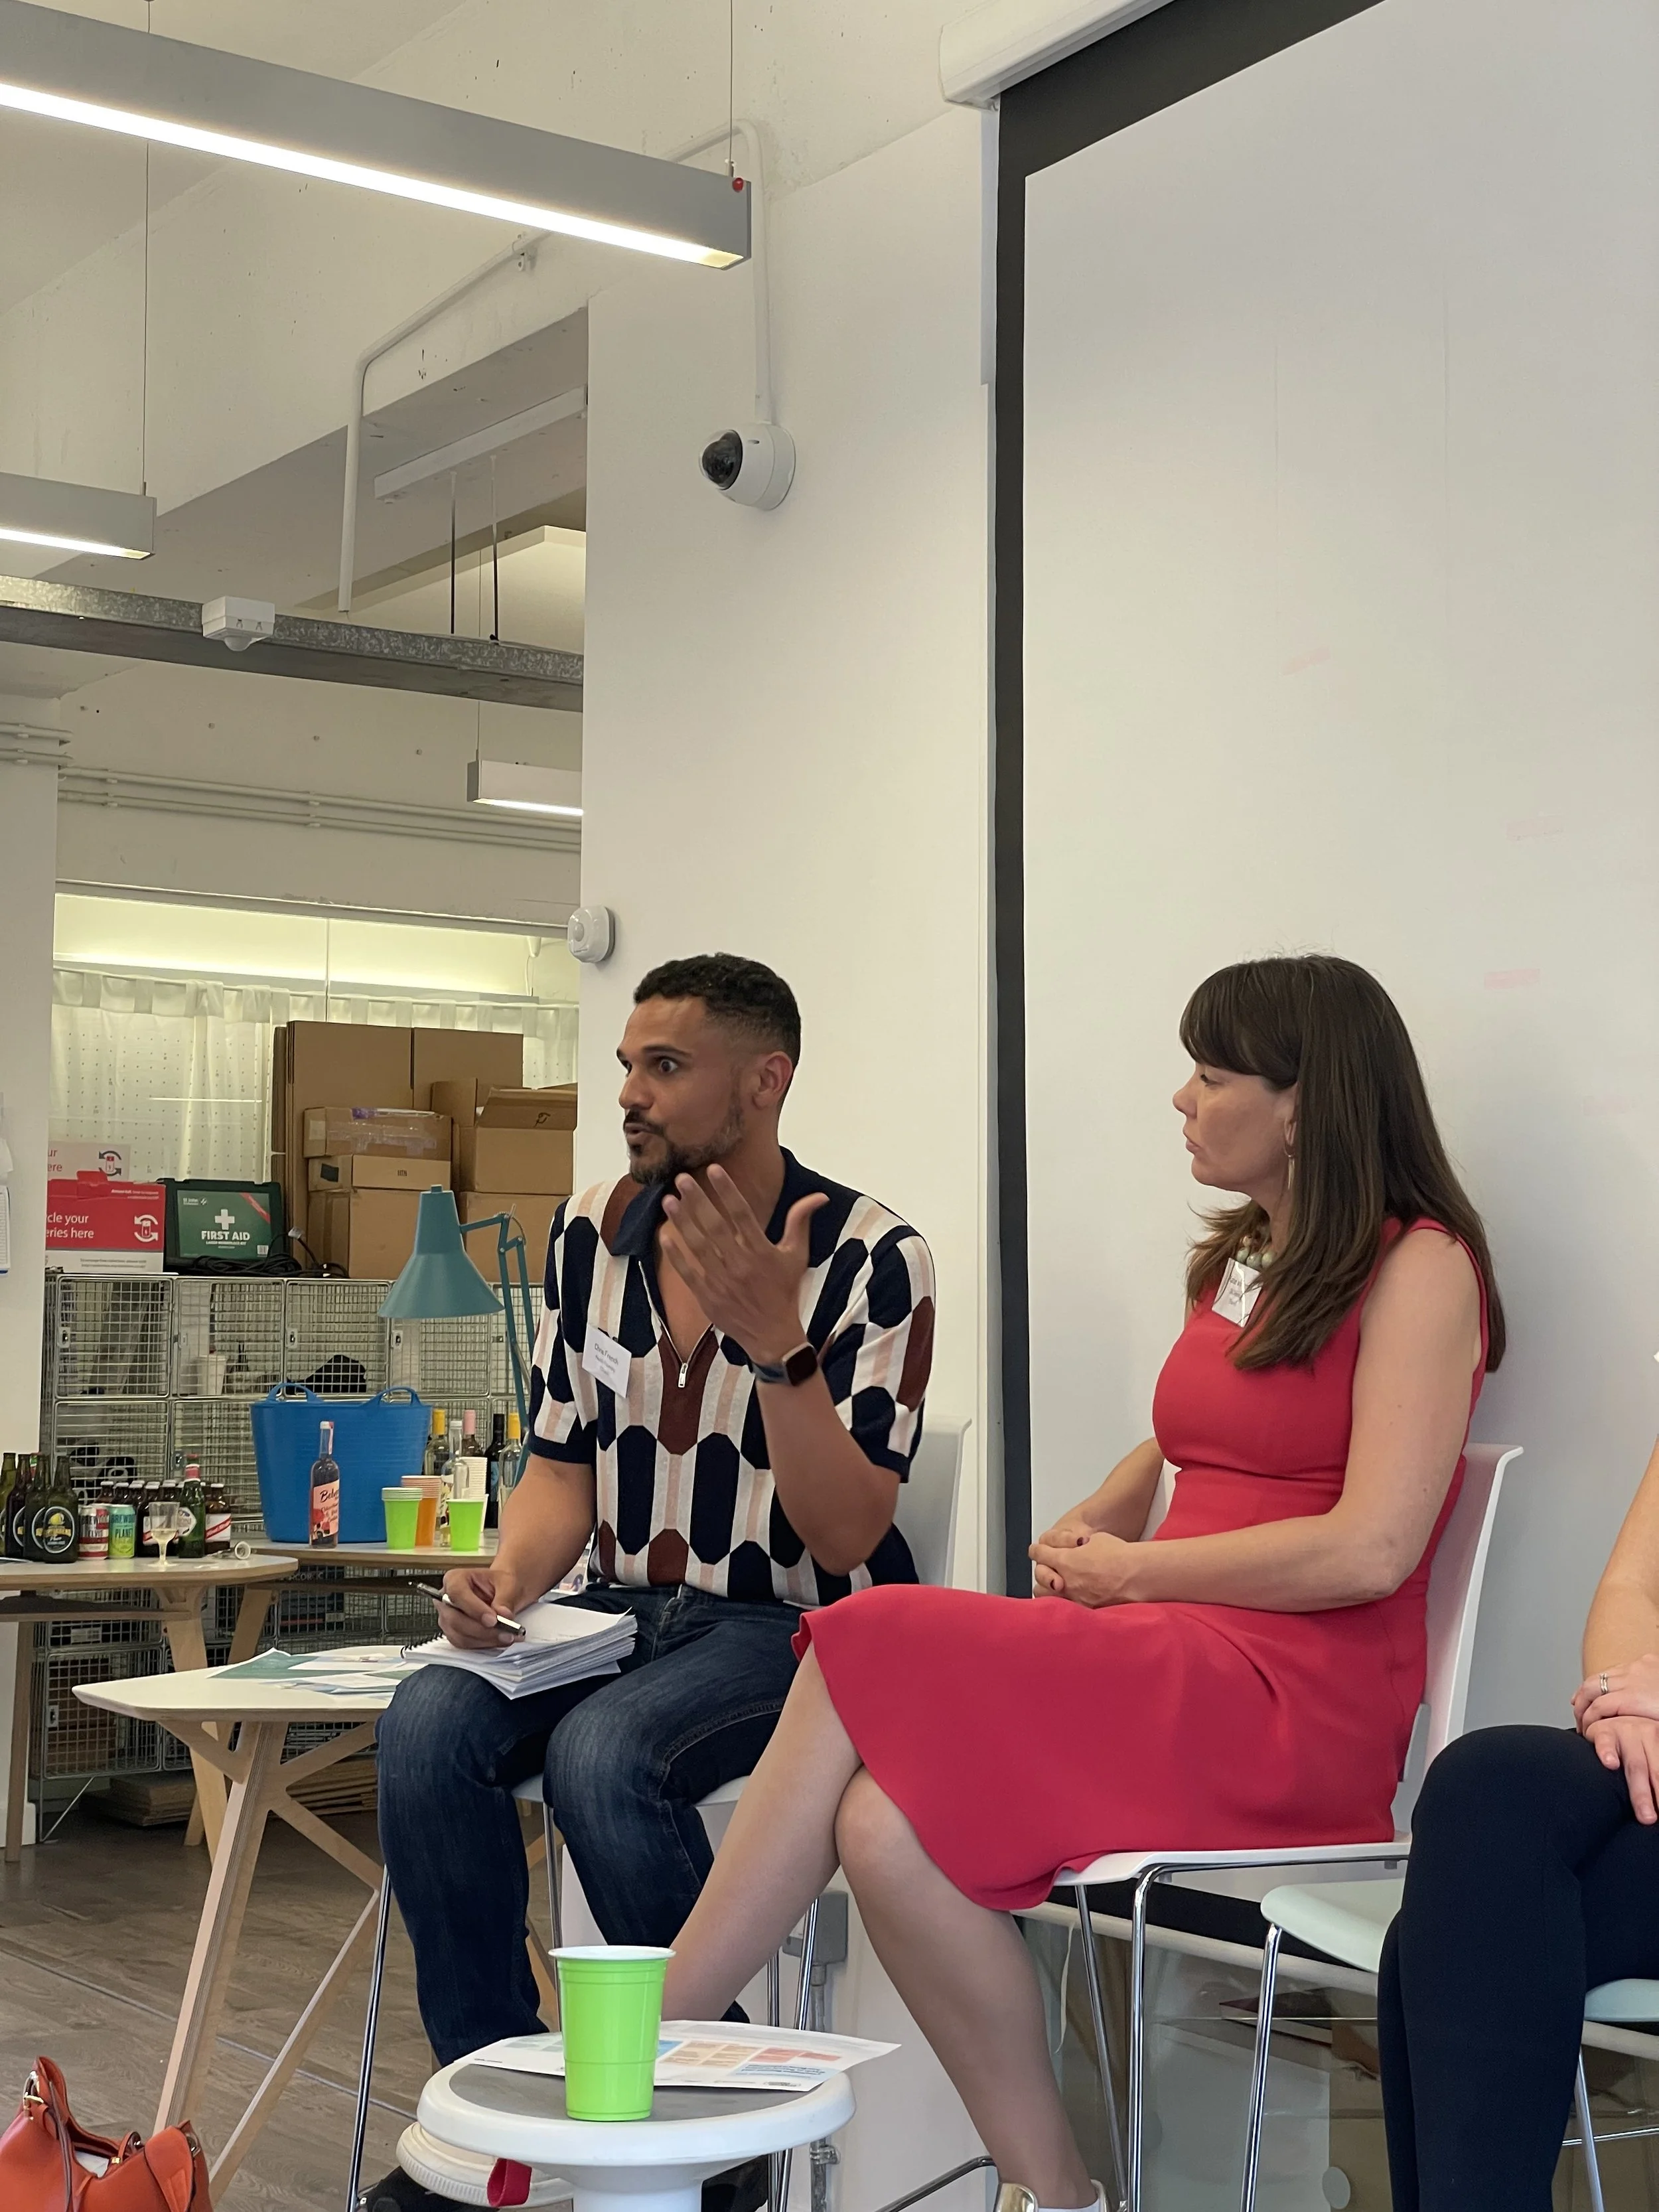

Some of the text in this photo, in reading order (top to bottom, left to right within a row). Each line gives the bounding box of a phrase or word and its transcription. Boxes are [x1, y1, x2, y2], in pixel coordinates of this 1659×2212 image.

[64, 1215, 89, 1226] your
[71, 1227, 94, 1238] here
[202, 1230, 250, 1241] FIRST AID
